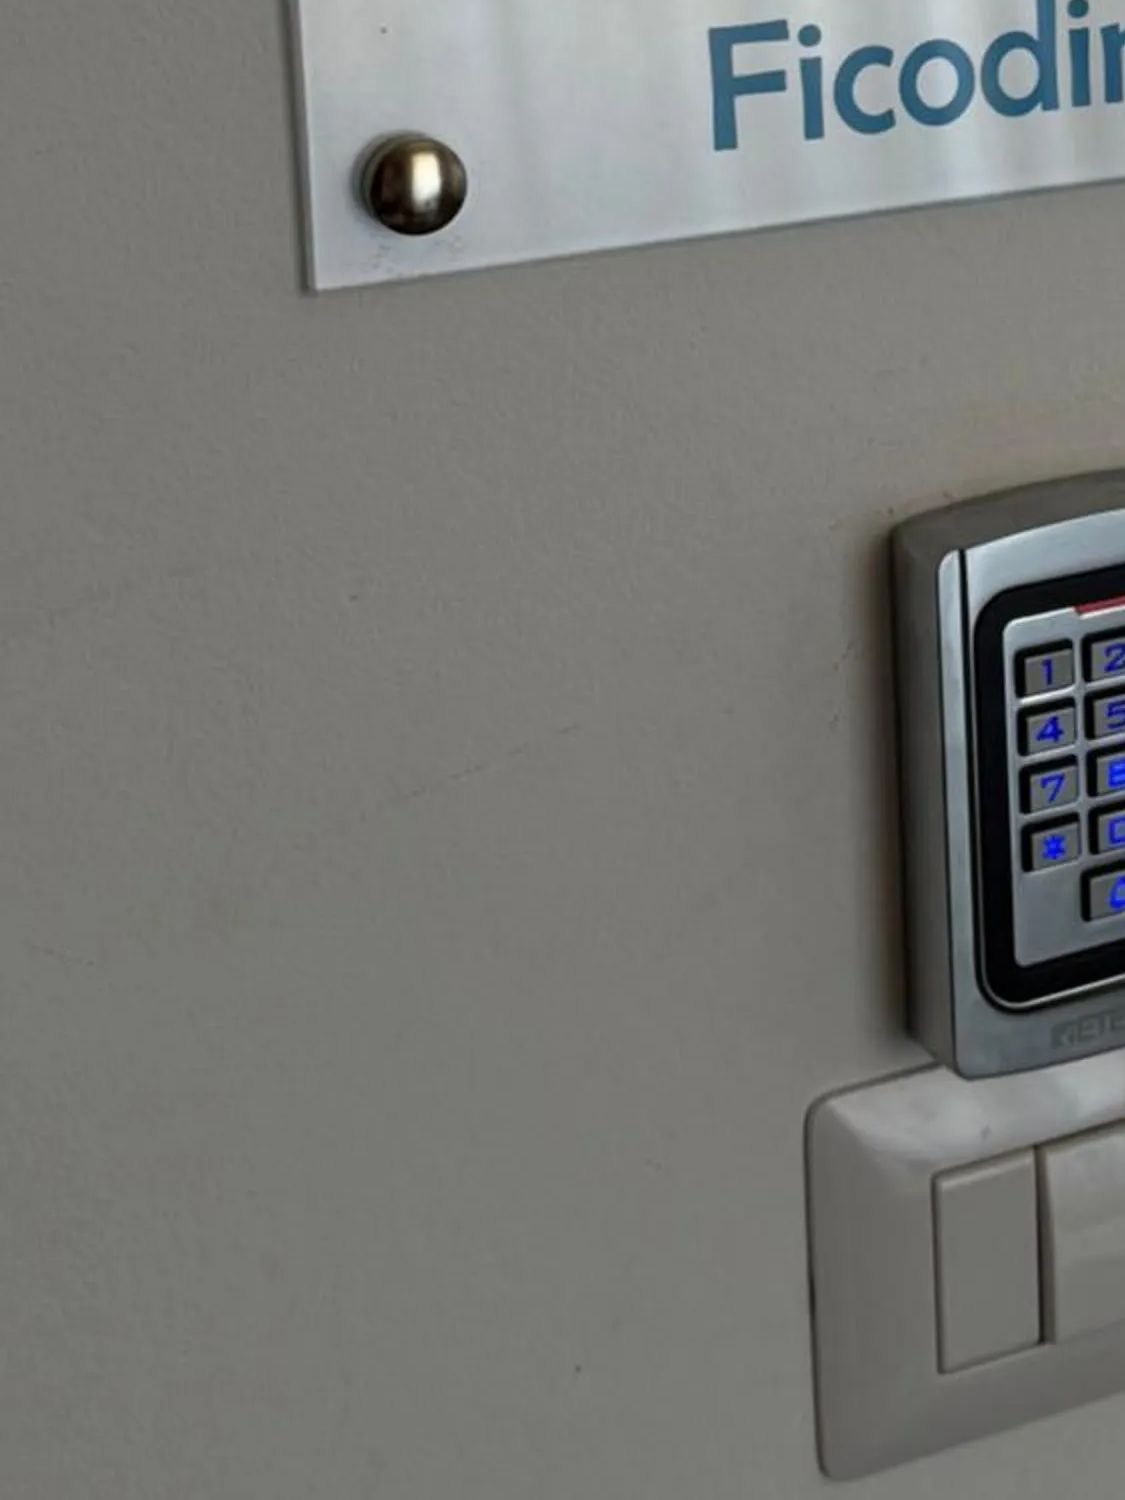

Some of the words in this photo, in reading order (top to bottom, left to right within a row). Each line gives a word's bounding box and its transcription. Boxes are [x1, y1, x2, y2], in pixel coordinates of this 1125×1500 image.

[1041, 659, 1053, 685] 1
[1036, 715, 1063, 742] 4
[1040, 773, 1065, 802] 7
